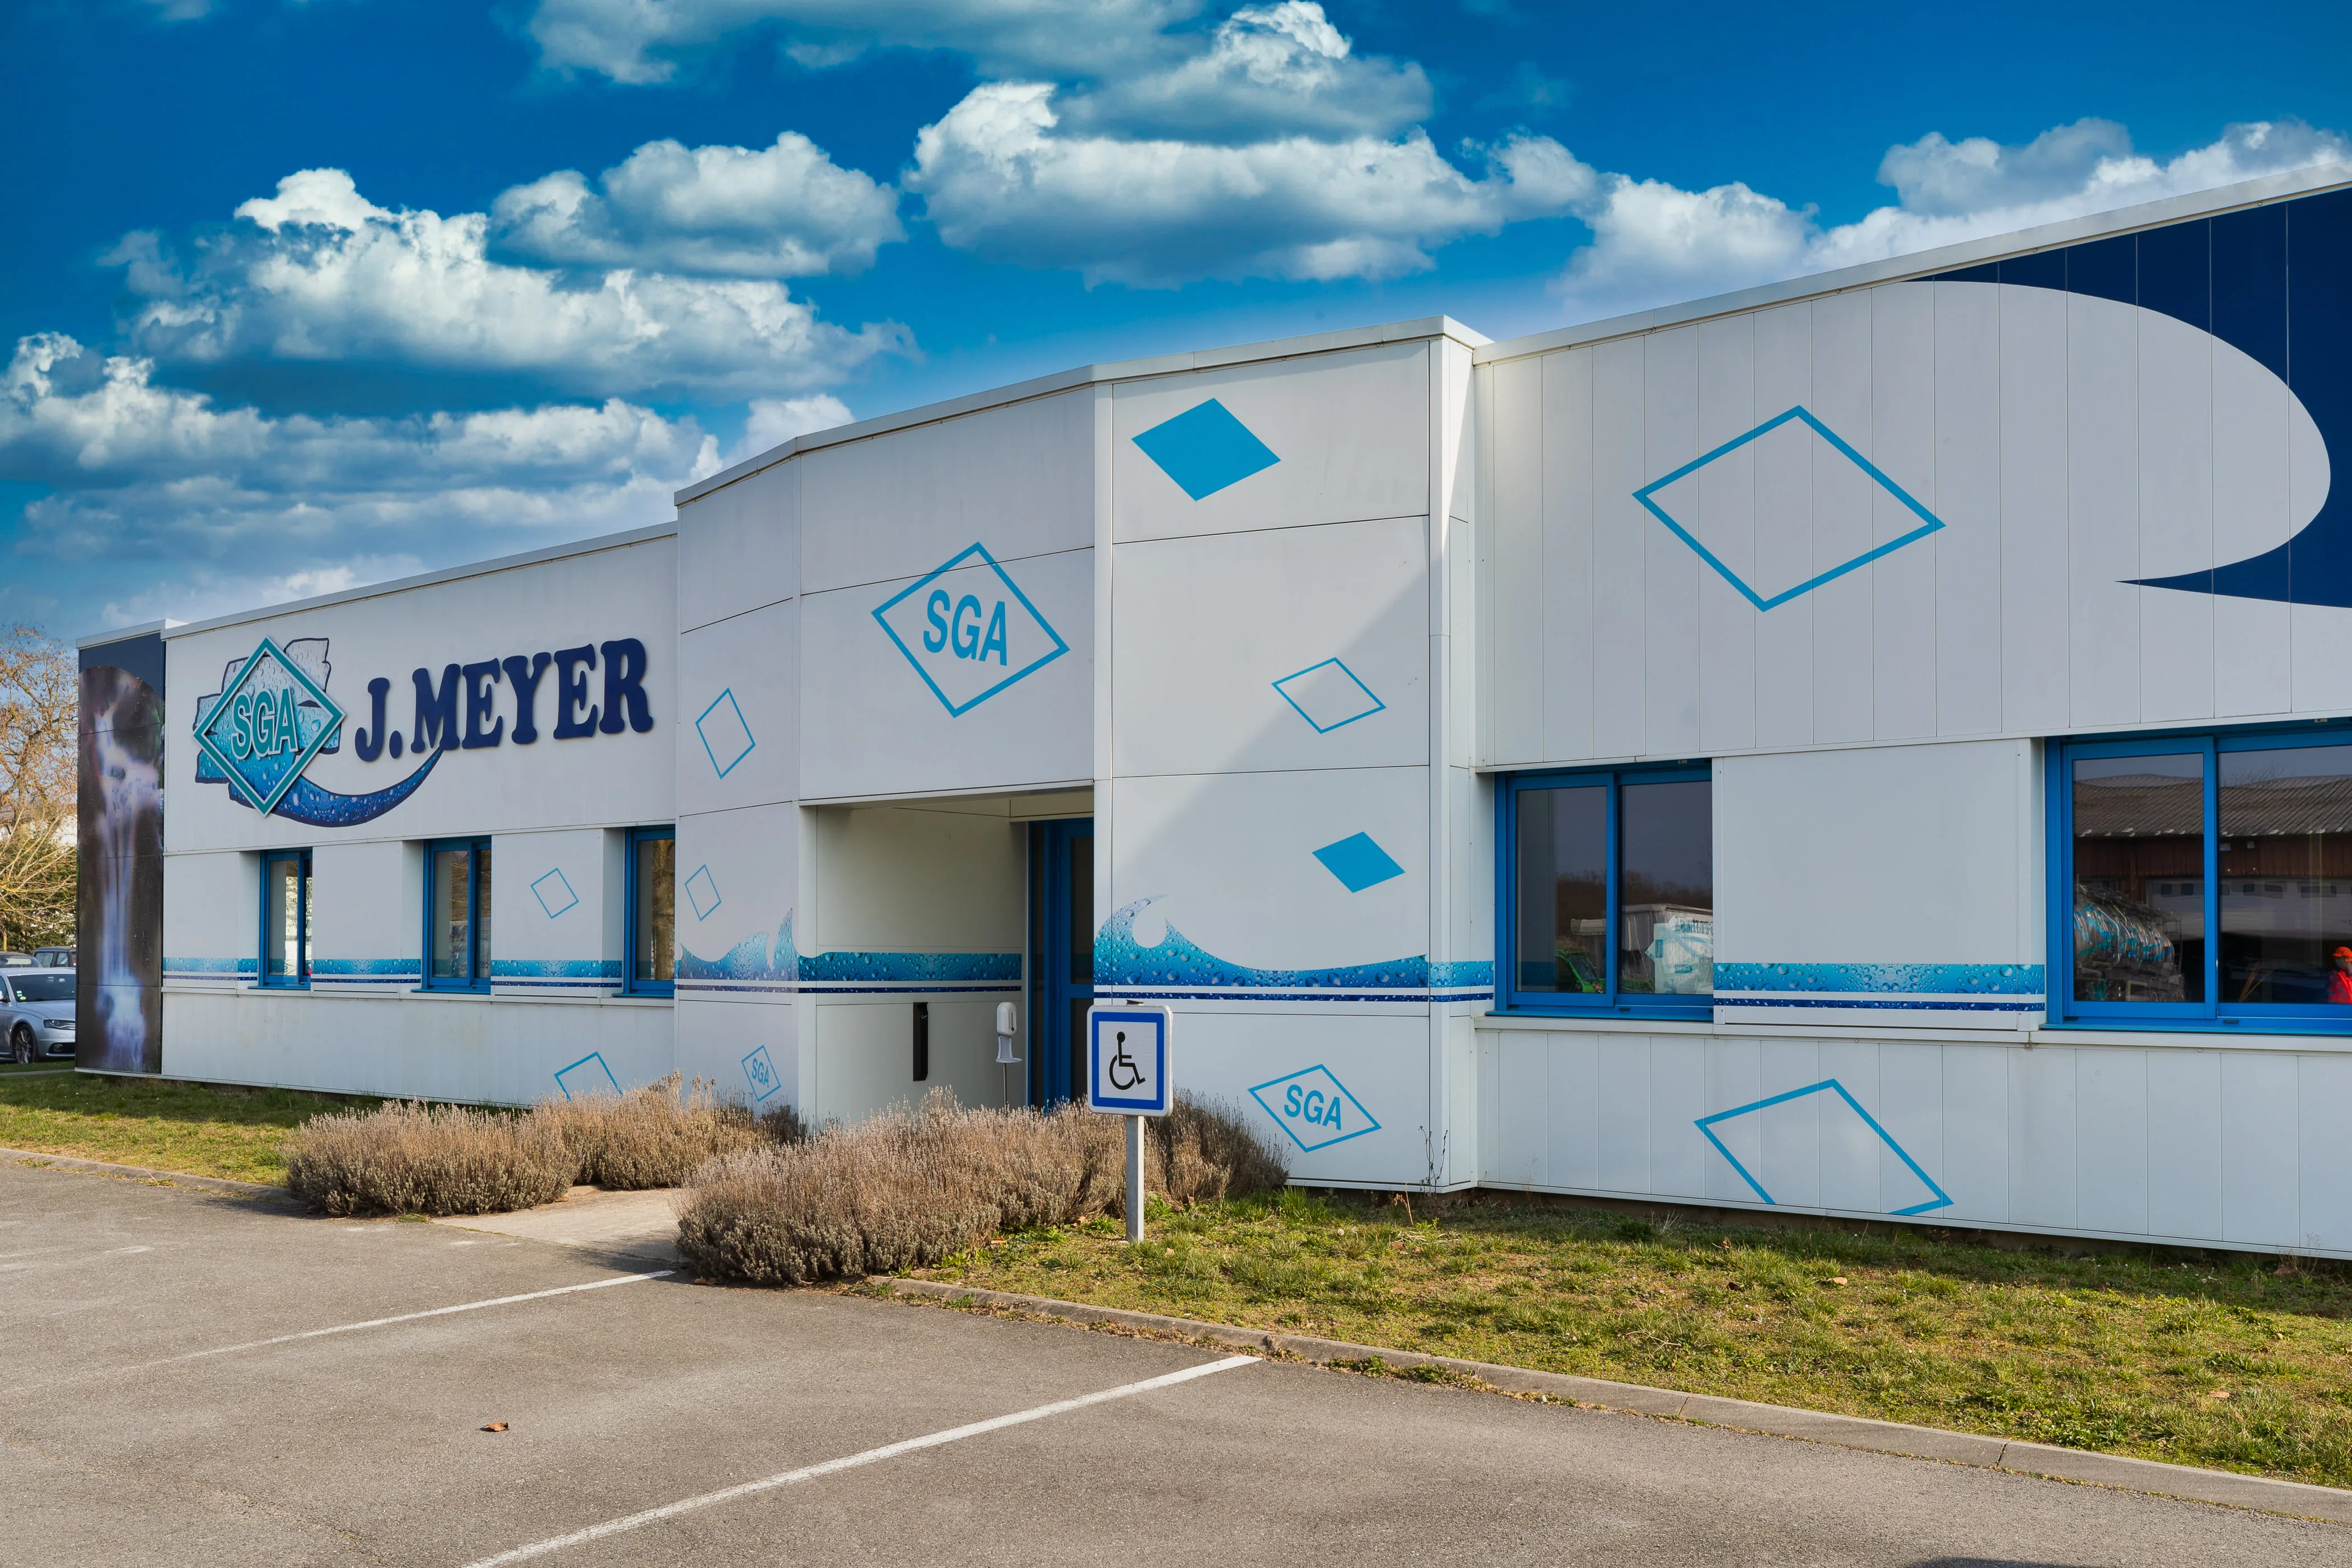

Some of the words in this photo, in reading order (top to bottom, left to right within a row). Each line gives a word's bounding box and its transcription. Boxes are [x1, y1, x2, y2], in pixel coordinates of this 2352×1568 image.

[923, 589, 1007, 666] SGA
[231, 687, 298, 760] SGA
[752, 1057, 769, 1088] SGA
[1284, 1084, 1342, 1131] SGA
